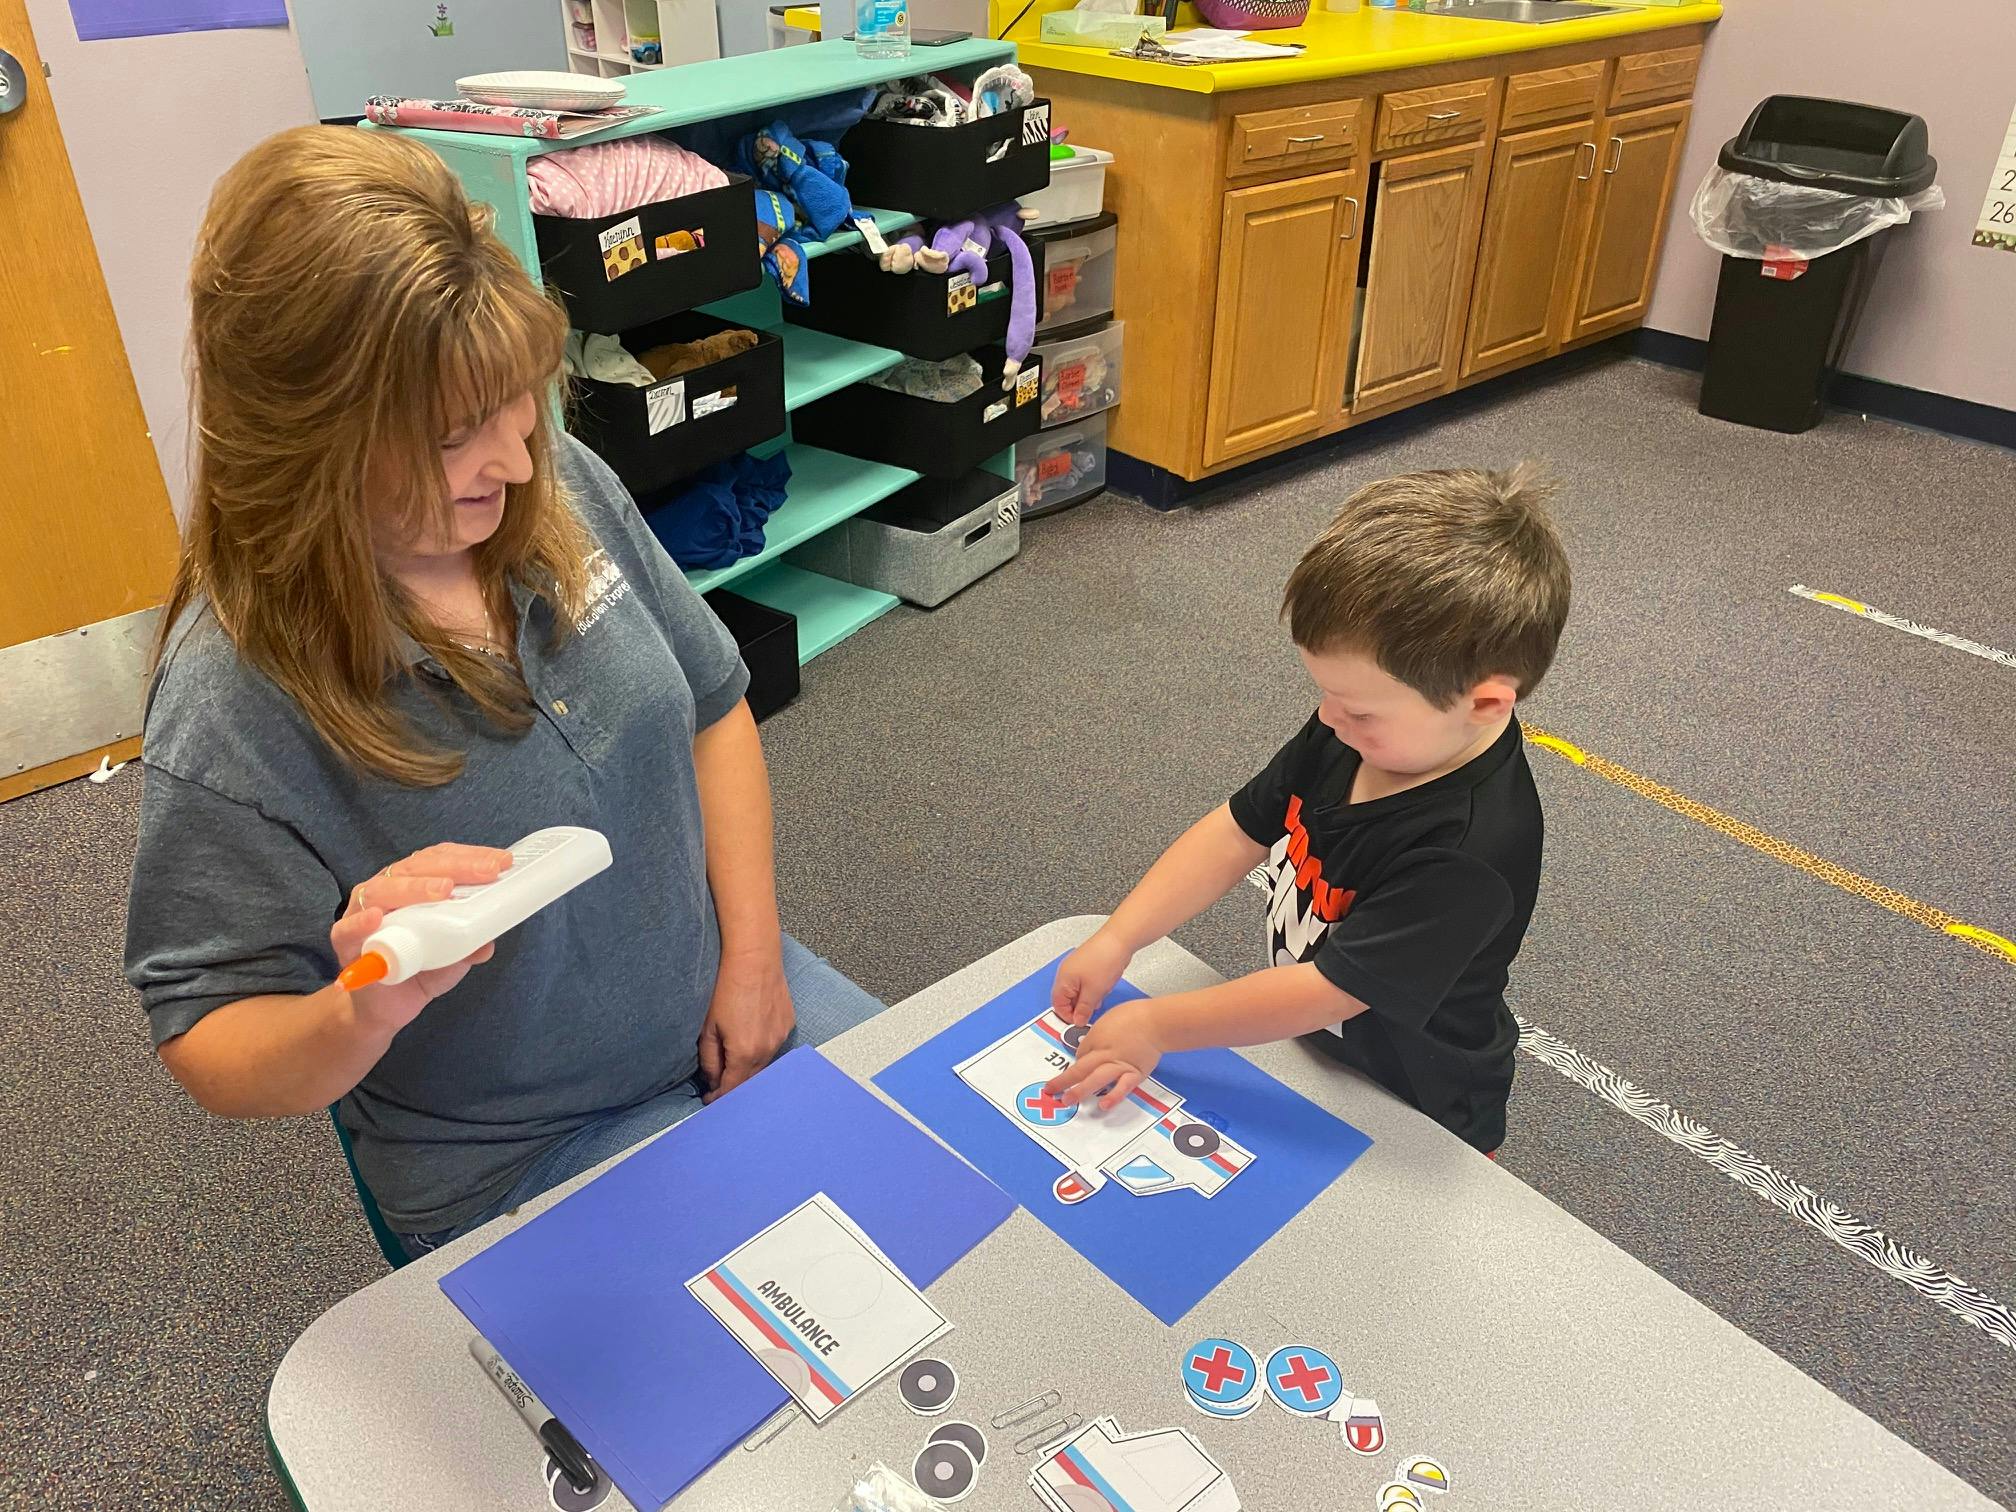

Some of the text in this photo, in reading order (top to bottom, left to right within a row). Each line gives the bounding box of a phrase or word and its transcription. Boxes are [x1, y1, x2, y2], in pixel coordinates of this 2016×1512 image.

[1989, 201, 2016, 224] 26
[757, 1280, 841, 1356] AMBULANCE
[504, 1375, 534, 1408] Sharpie
